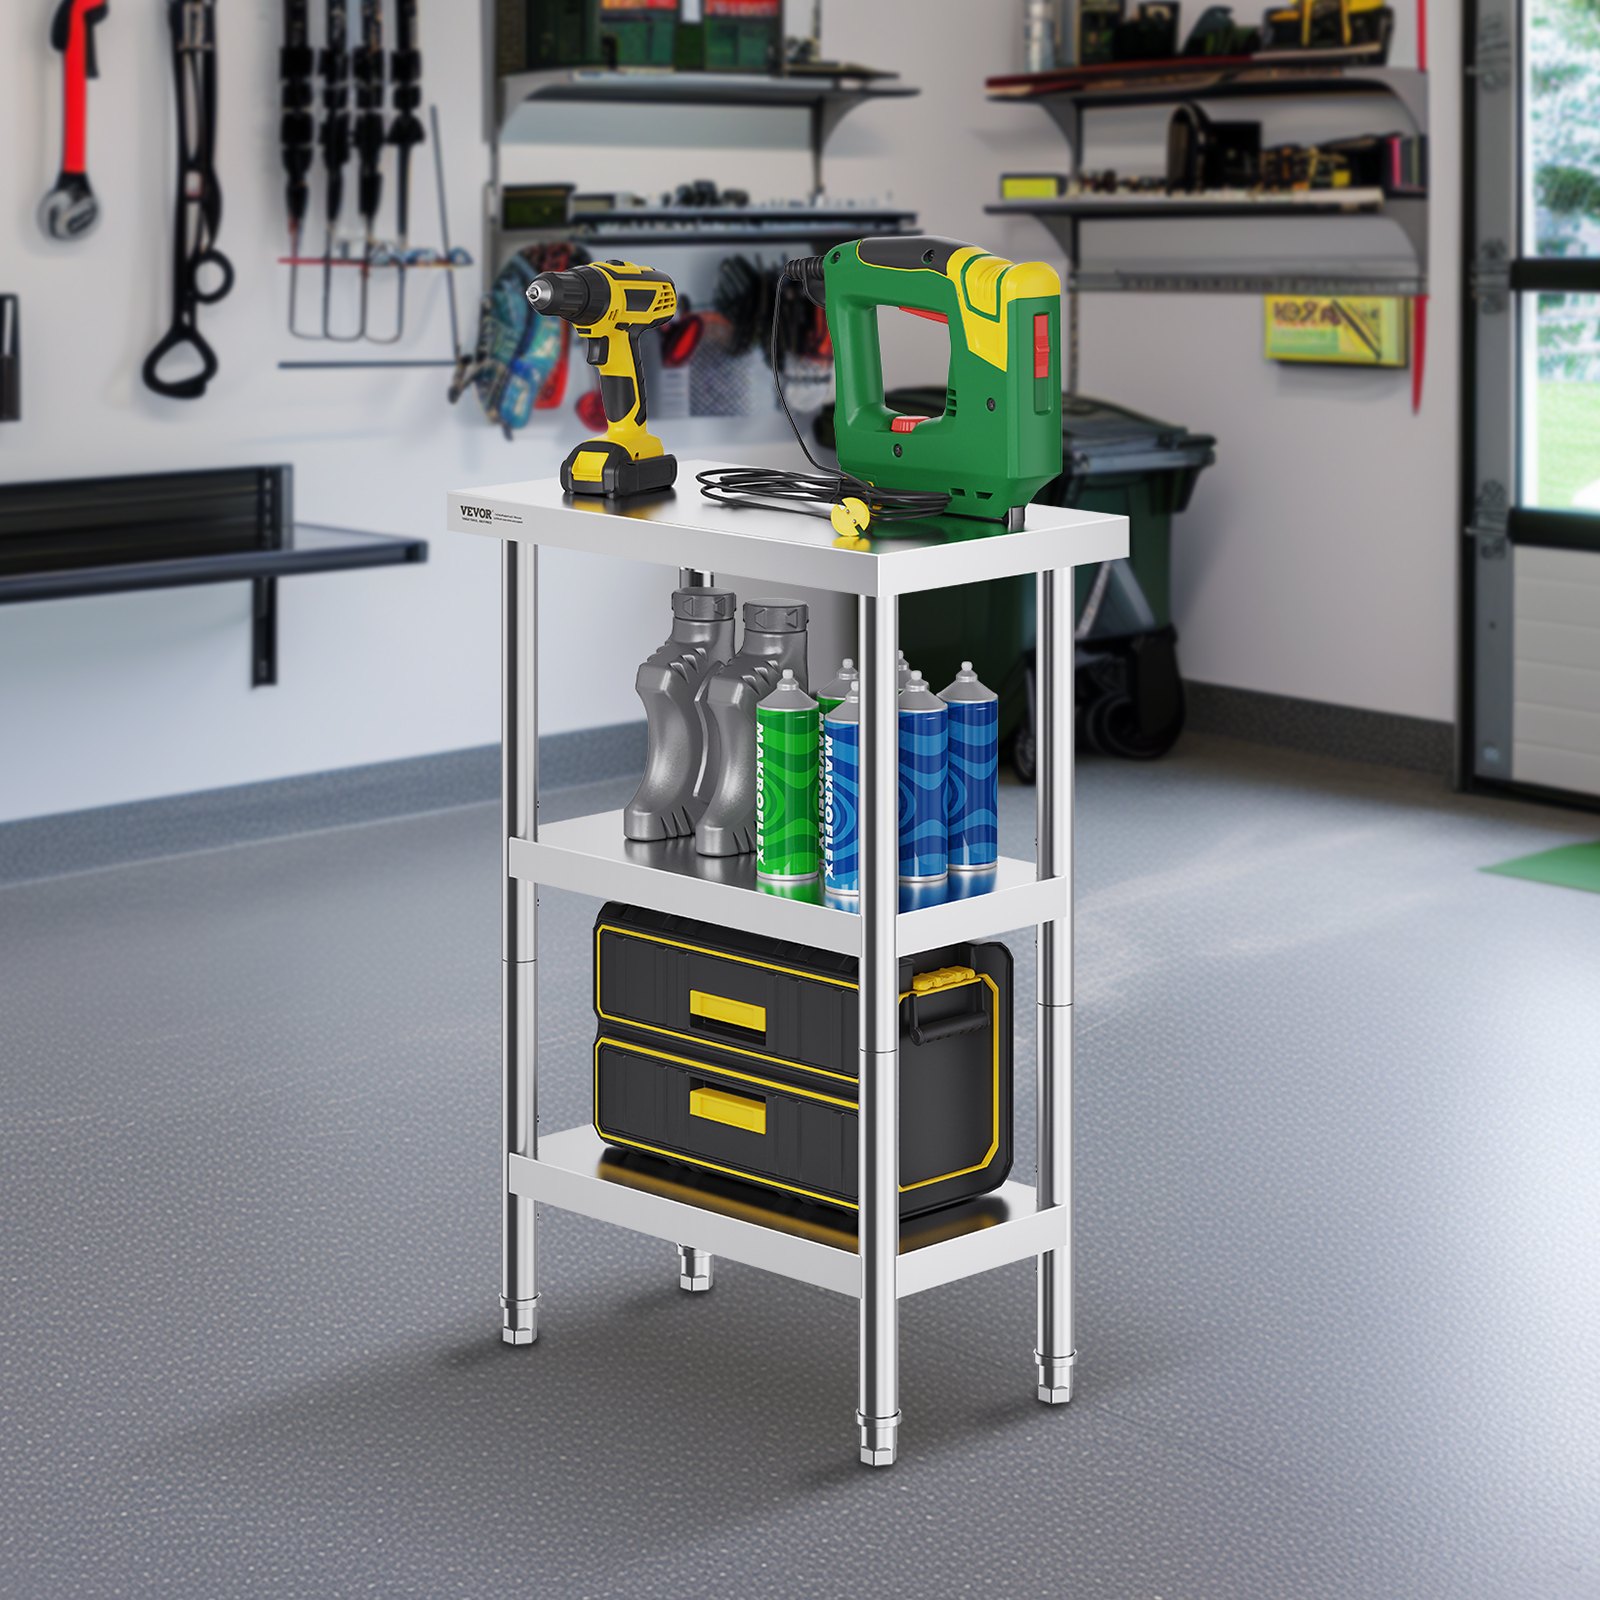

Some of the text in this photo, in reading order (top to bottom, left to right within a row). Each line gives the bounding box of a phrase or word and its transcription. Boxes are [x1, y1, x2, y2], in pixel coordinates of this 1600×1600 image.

[460, 505, 492, 520] VEVOR
[756, 721, 765, 866] MAKROFLEX
[825, 734, 835, 880] MAKROFLEX
